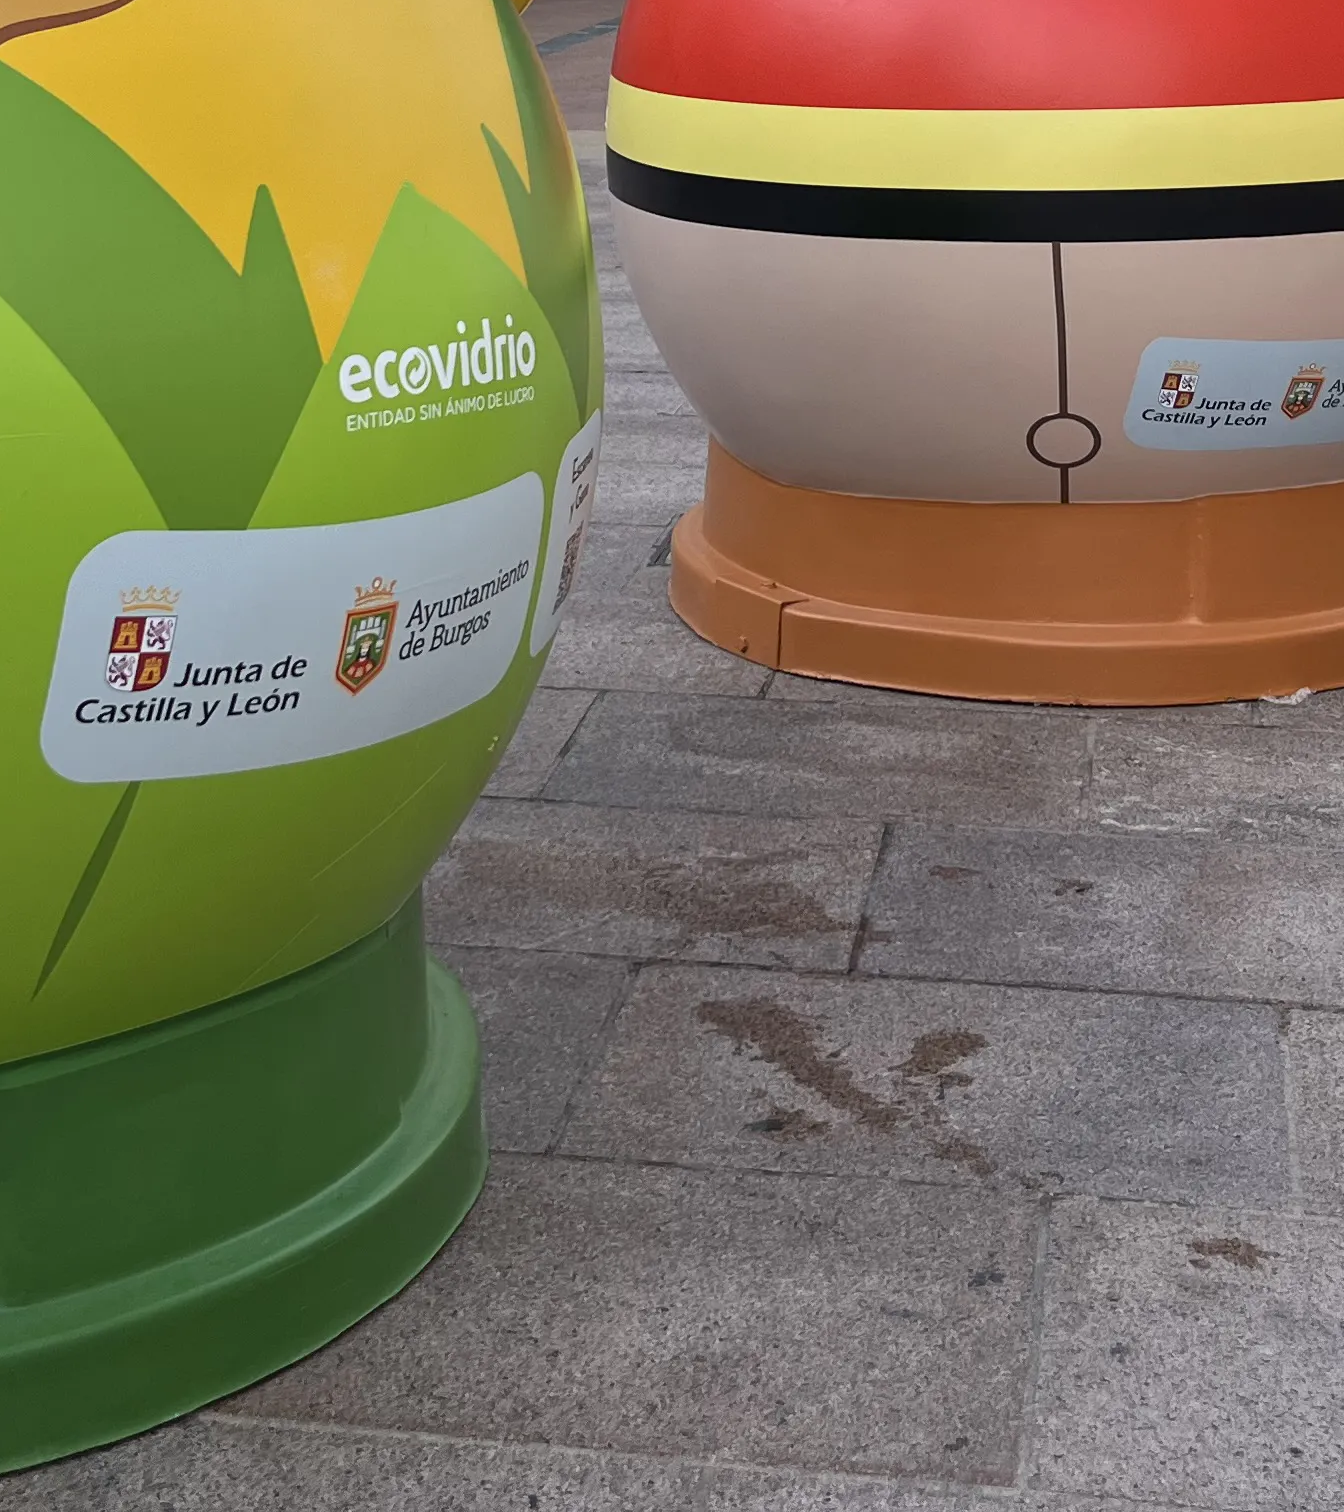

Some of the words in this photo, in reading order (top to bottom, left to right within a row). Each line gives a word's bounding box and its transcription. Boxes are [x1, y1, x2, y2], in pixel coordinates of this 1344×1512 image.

[338, 313, 537, 403] ecovidrio
[346, 406, 416, 432] ENTIDAD
[419, 403, 442, 422] SIN
[445, 394, 486, 418] ÁNIMO
[487, 391, 504, 410] DE
[504, 385, 535, 407] LUCRO
[1141, 408, 1206, 426] Castilla
[1206, 415, 1221, 429] y
[1223, 413, 1268, 427] León
[1194, 397, 1246, 411] Junta
[1250, 398, 1273, 412] de
[1321, 393, 1341, 409] de
[404, 559, 530, 633] Ayuntamiento
[398, 630, 426, 661] de
[428, 610, 492, 653] Burgos
[172, 660, 264, 688] Junta
[270, 654, 308, 681] de
[74, 696, 193, 724] Castilla
[195, 699, 220, 728] y
[226, 687, 301, 717] León
